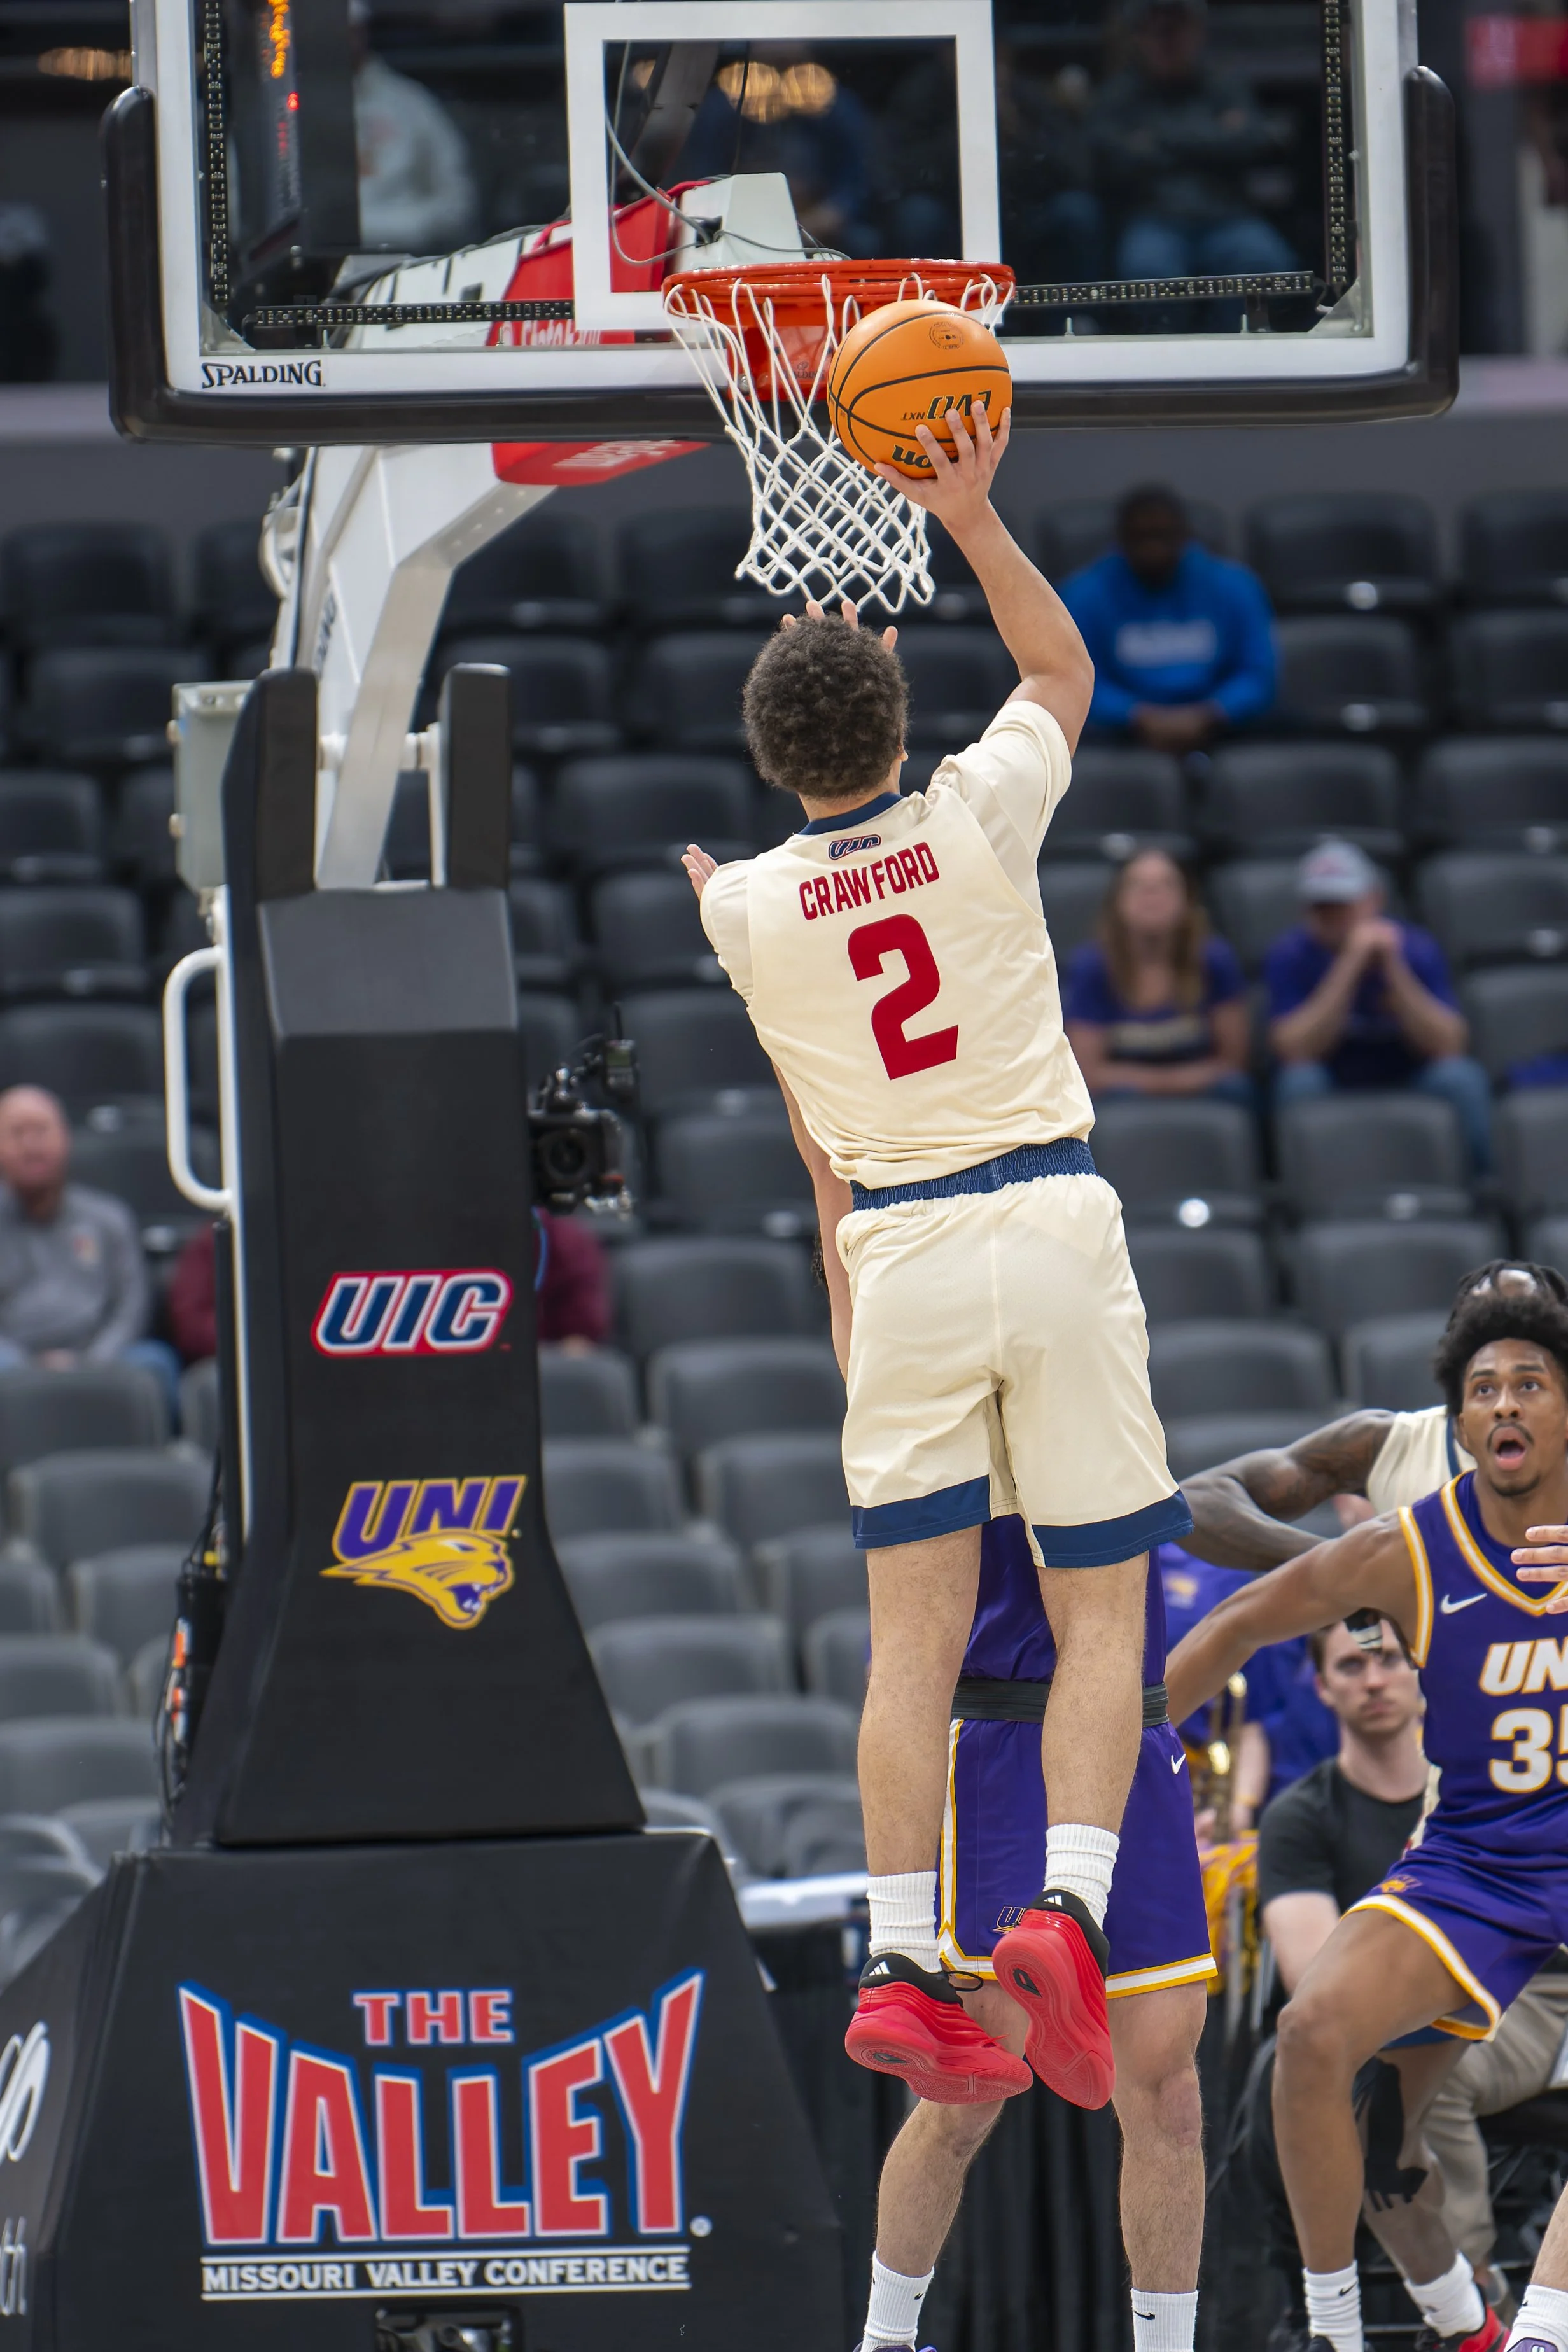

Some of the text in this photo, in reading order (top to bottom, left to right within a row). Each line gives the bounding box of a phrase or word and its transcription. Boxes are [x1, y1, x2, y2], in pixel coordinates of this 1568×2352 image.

[201, 359, 322, 389] SPALDING
[900, 412, 926, 421] NXT
[799, 841, 940, 921] CRAWFORD
[846, 913, 959, 1081] 2
[313, 1269, 512, 1356] UIC
[332, 1474, 527, 1565] UNI
[353, 1989, 515, 2045] THE
[178, 1968, 704, 2246] VALLEY
[202, 2255, 689, 2292] MISSOURI VALLEY CONFERENCE
